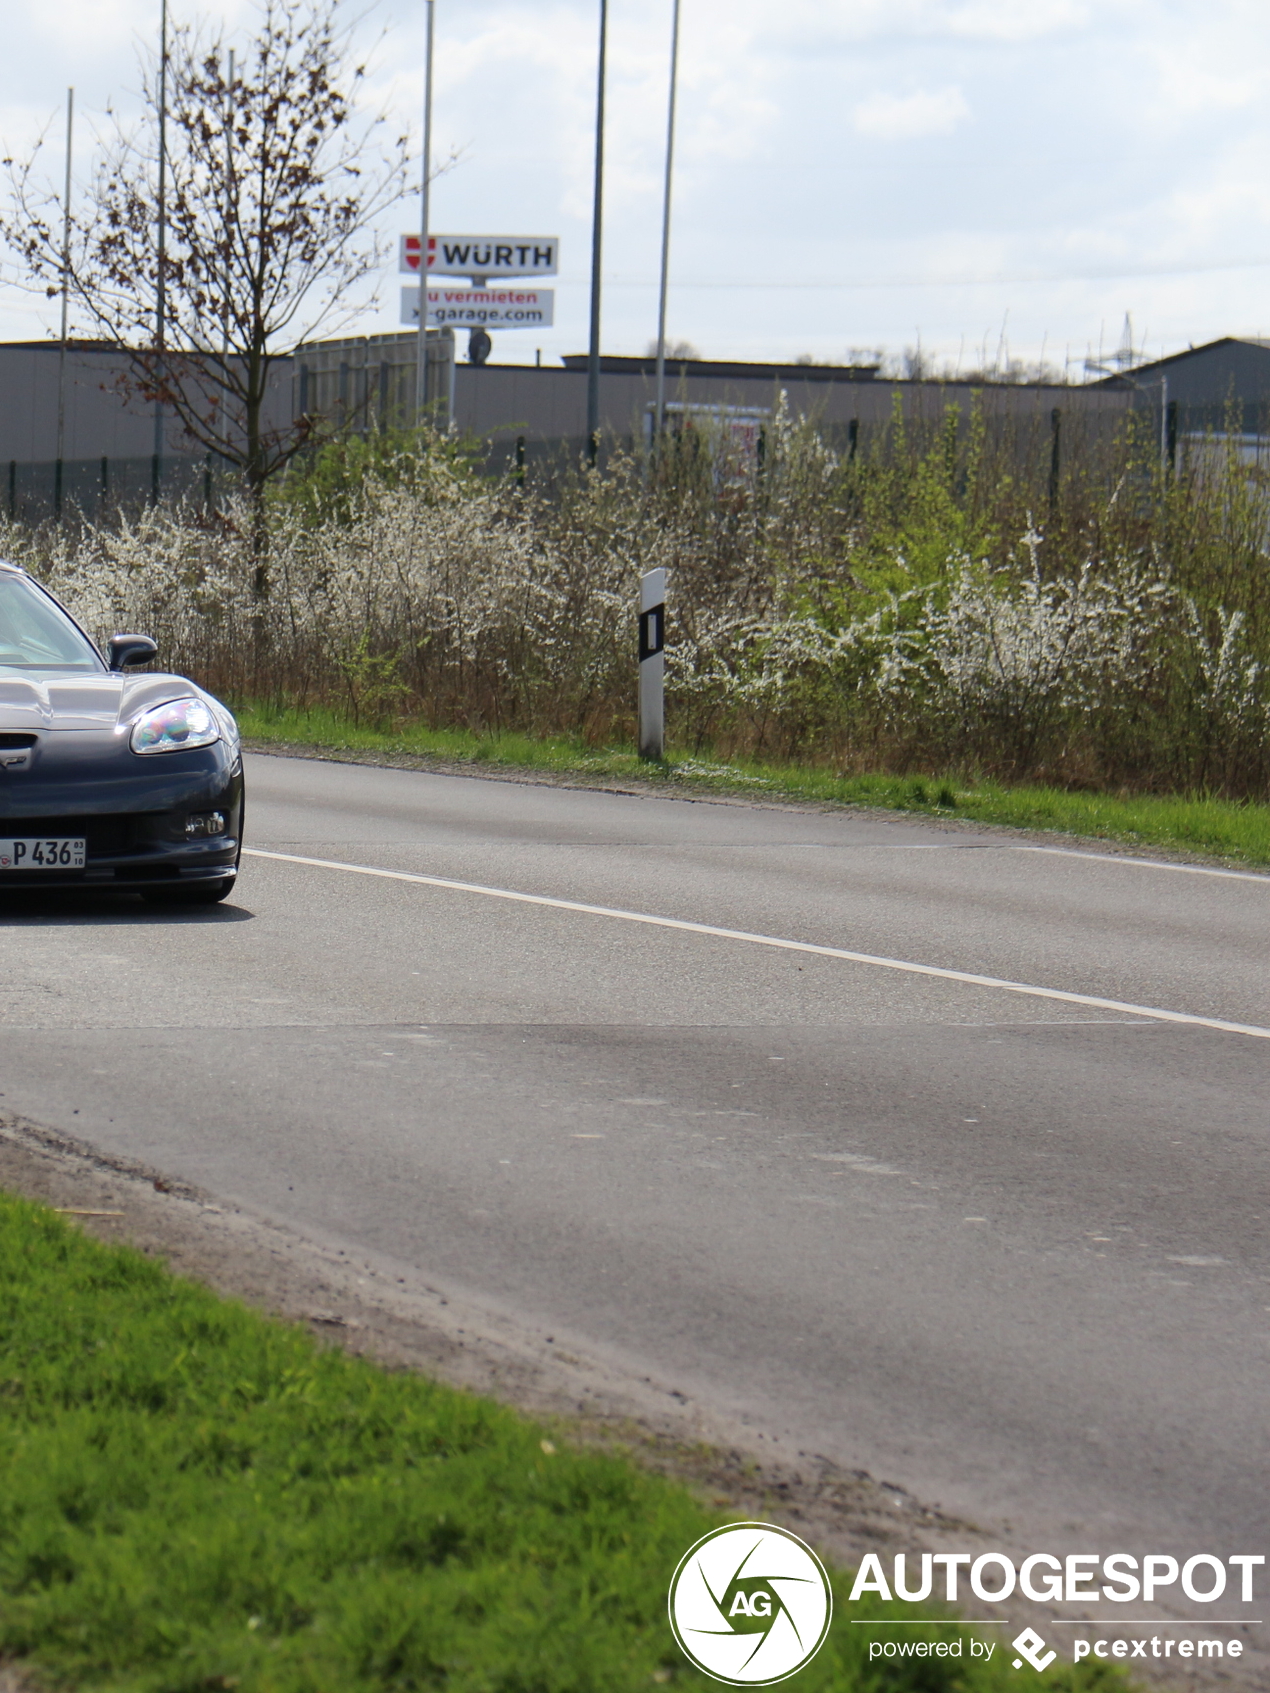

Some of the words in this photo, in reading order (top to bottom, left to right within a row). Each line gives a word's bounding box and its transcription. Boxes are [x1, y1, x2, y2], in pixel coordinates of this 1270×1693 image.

[443, 244, 552, 266] WÜRTH
[444, 291, 537, 304] vermieten
[412, 308, 542, 324] x-garage.com
[14, 842, 26, 865] P
[32, 842, 71, 865] 436
